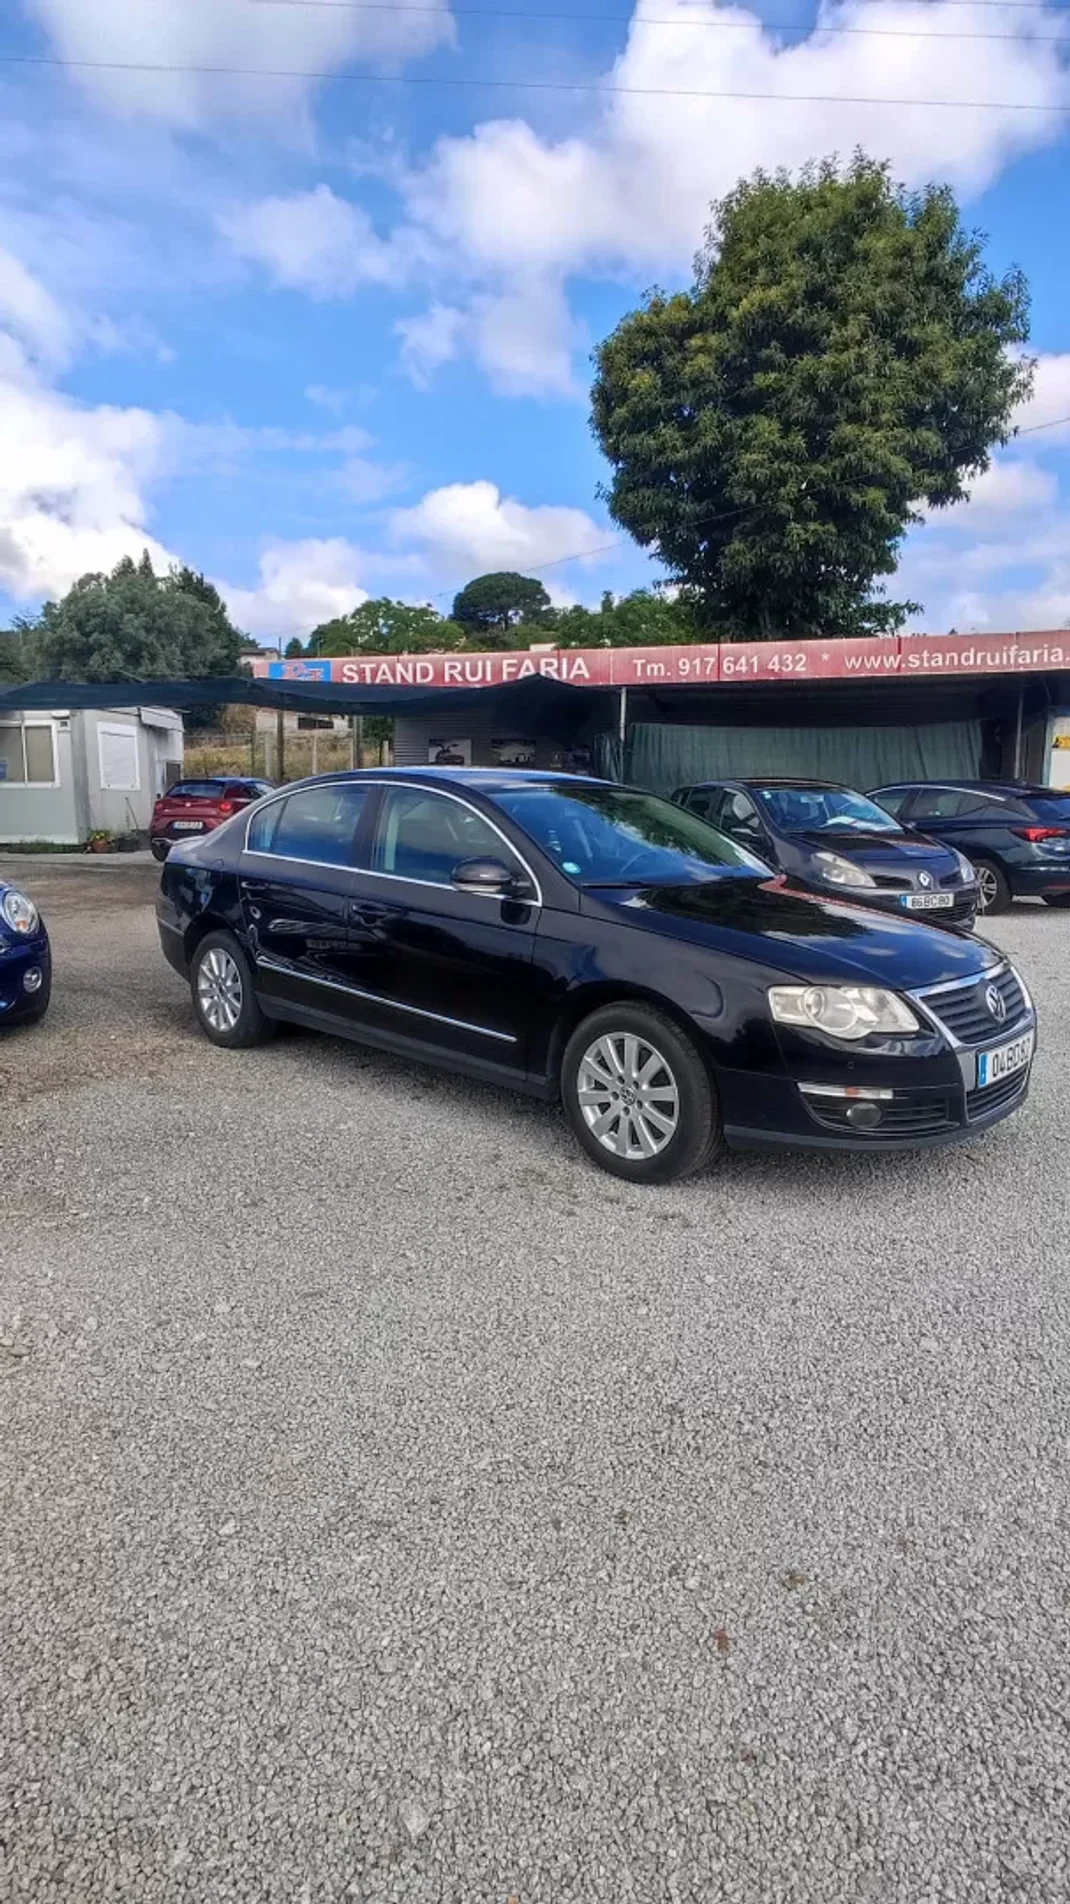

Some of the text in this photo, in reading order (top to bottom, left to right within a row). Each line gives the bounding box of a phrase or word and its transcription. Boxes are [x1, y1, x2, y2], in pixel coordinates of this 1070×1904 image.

[341, 661, 434, 685] STAND
[443, 659, 493, 682] RUI
[501, 656, 591, 681] FARIA
[633, 659, 672, 677] Tm.
[678, 656, 716, 676] 917
[722, 655, 760, 674] 641
[767, 653, 808, 673] 432
